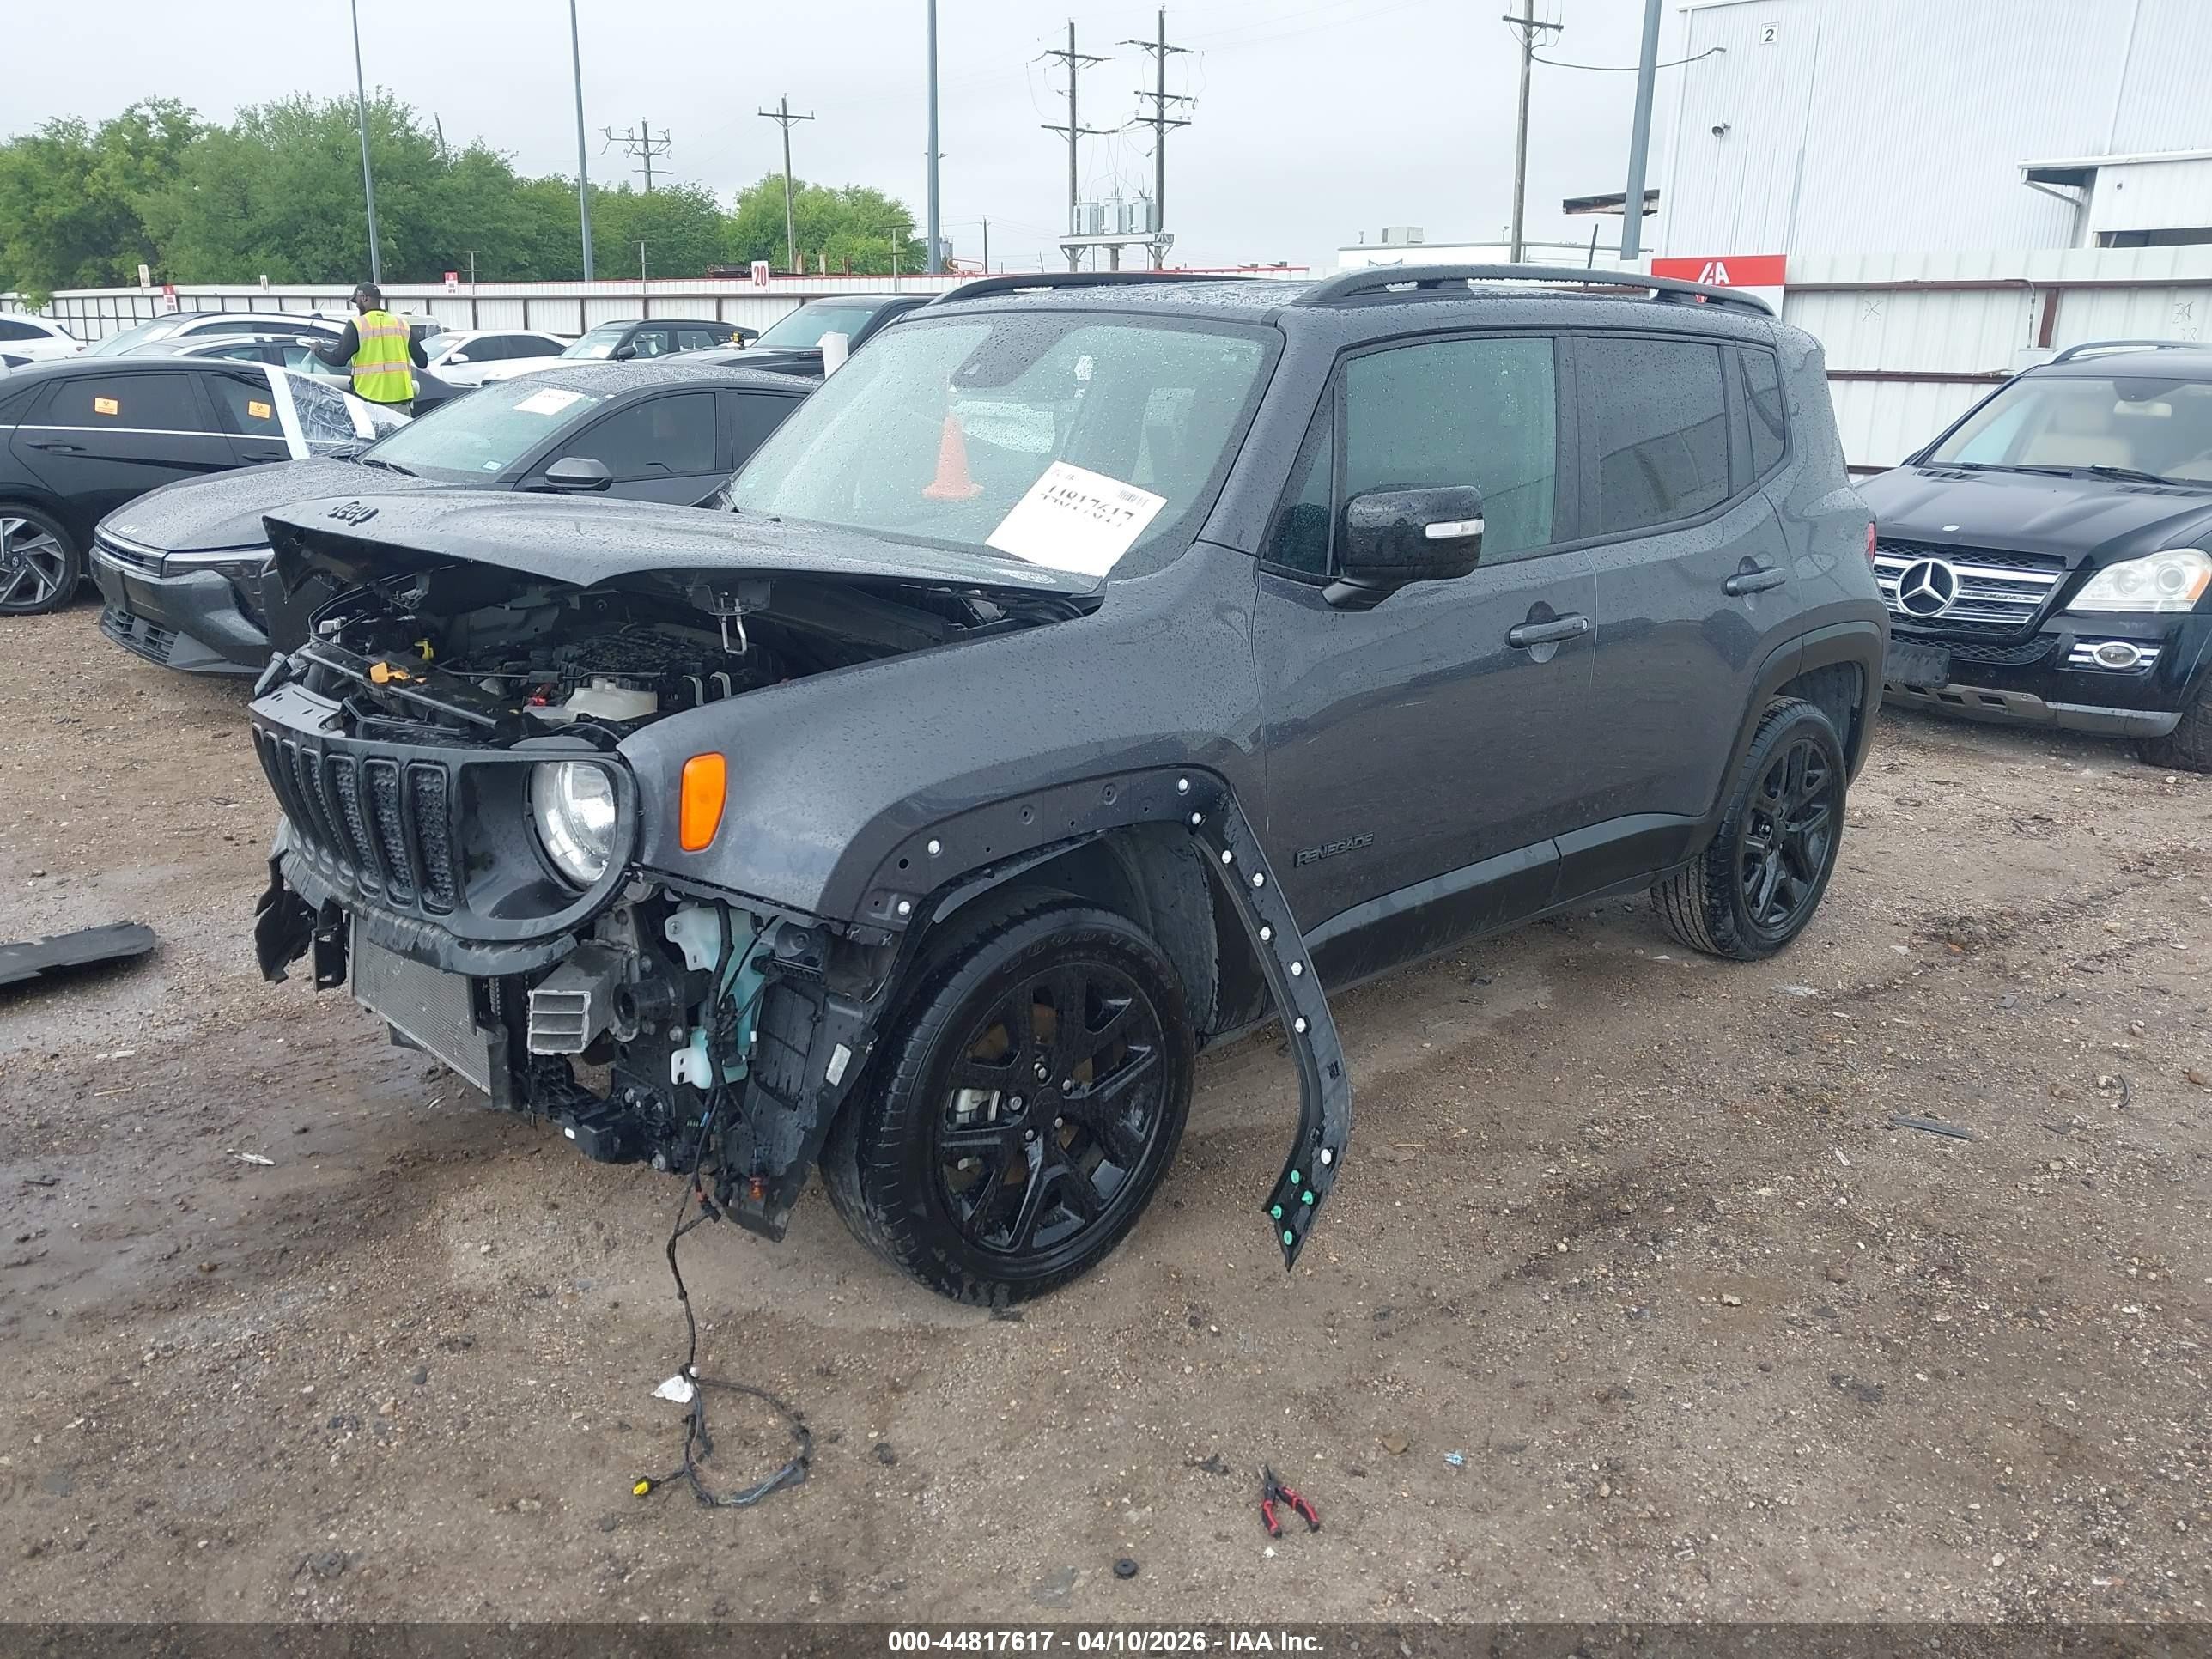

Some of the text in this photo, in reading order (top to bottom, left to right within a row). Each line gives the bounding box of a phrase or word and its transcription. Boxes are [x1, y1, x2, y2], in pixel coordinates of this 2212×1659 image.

[1765, 28, 1774, 42] 2
[754, 265, 767, 287] 20
[327, 501, 379, 526] Jeep
[1294, 831, 1374, 867] RENEGADE
